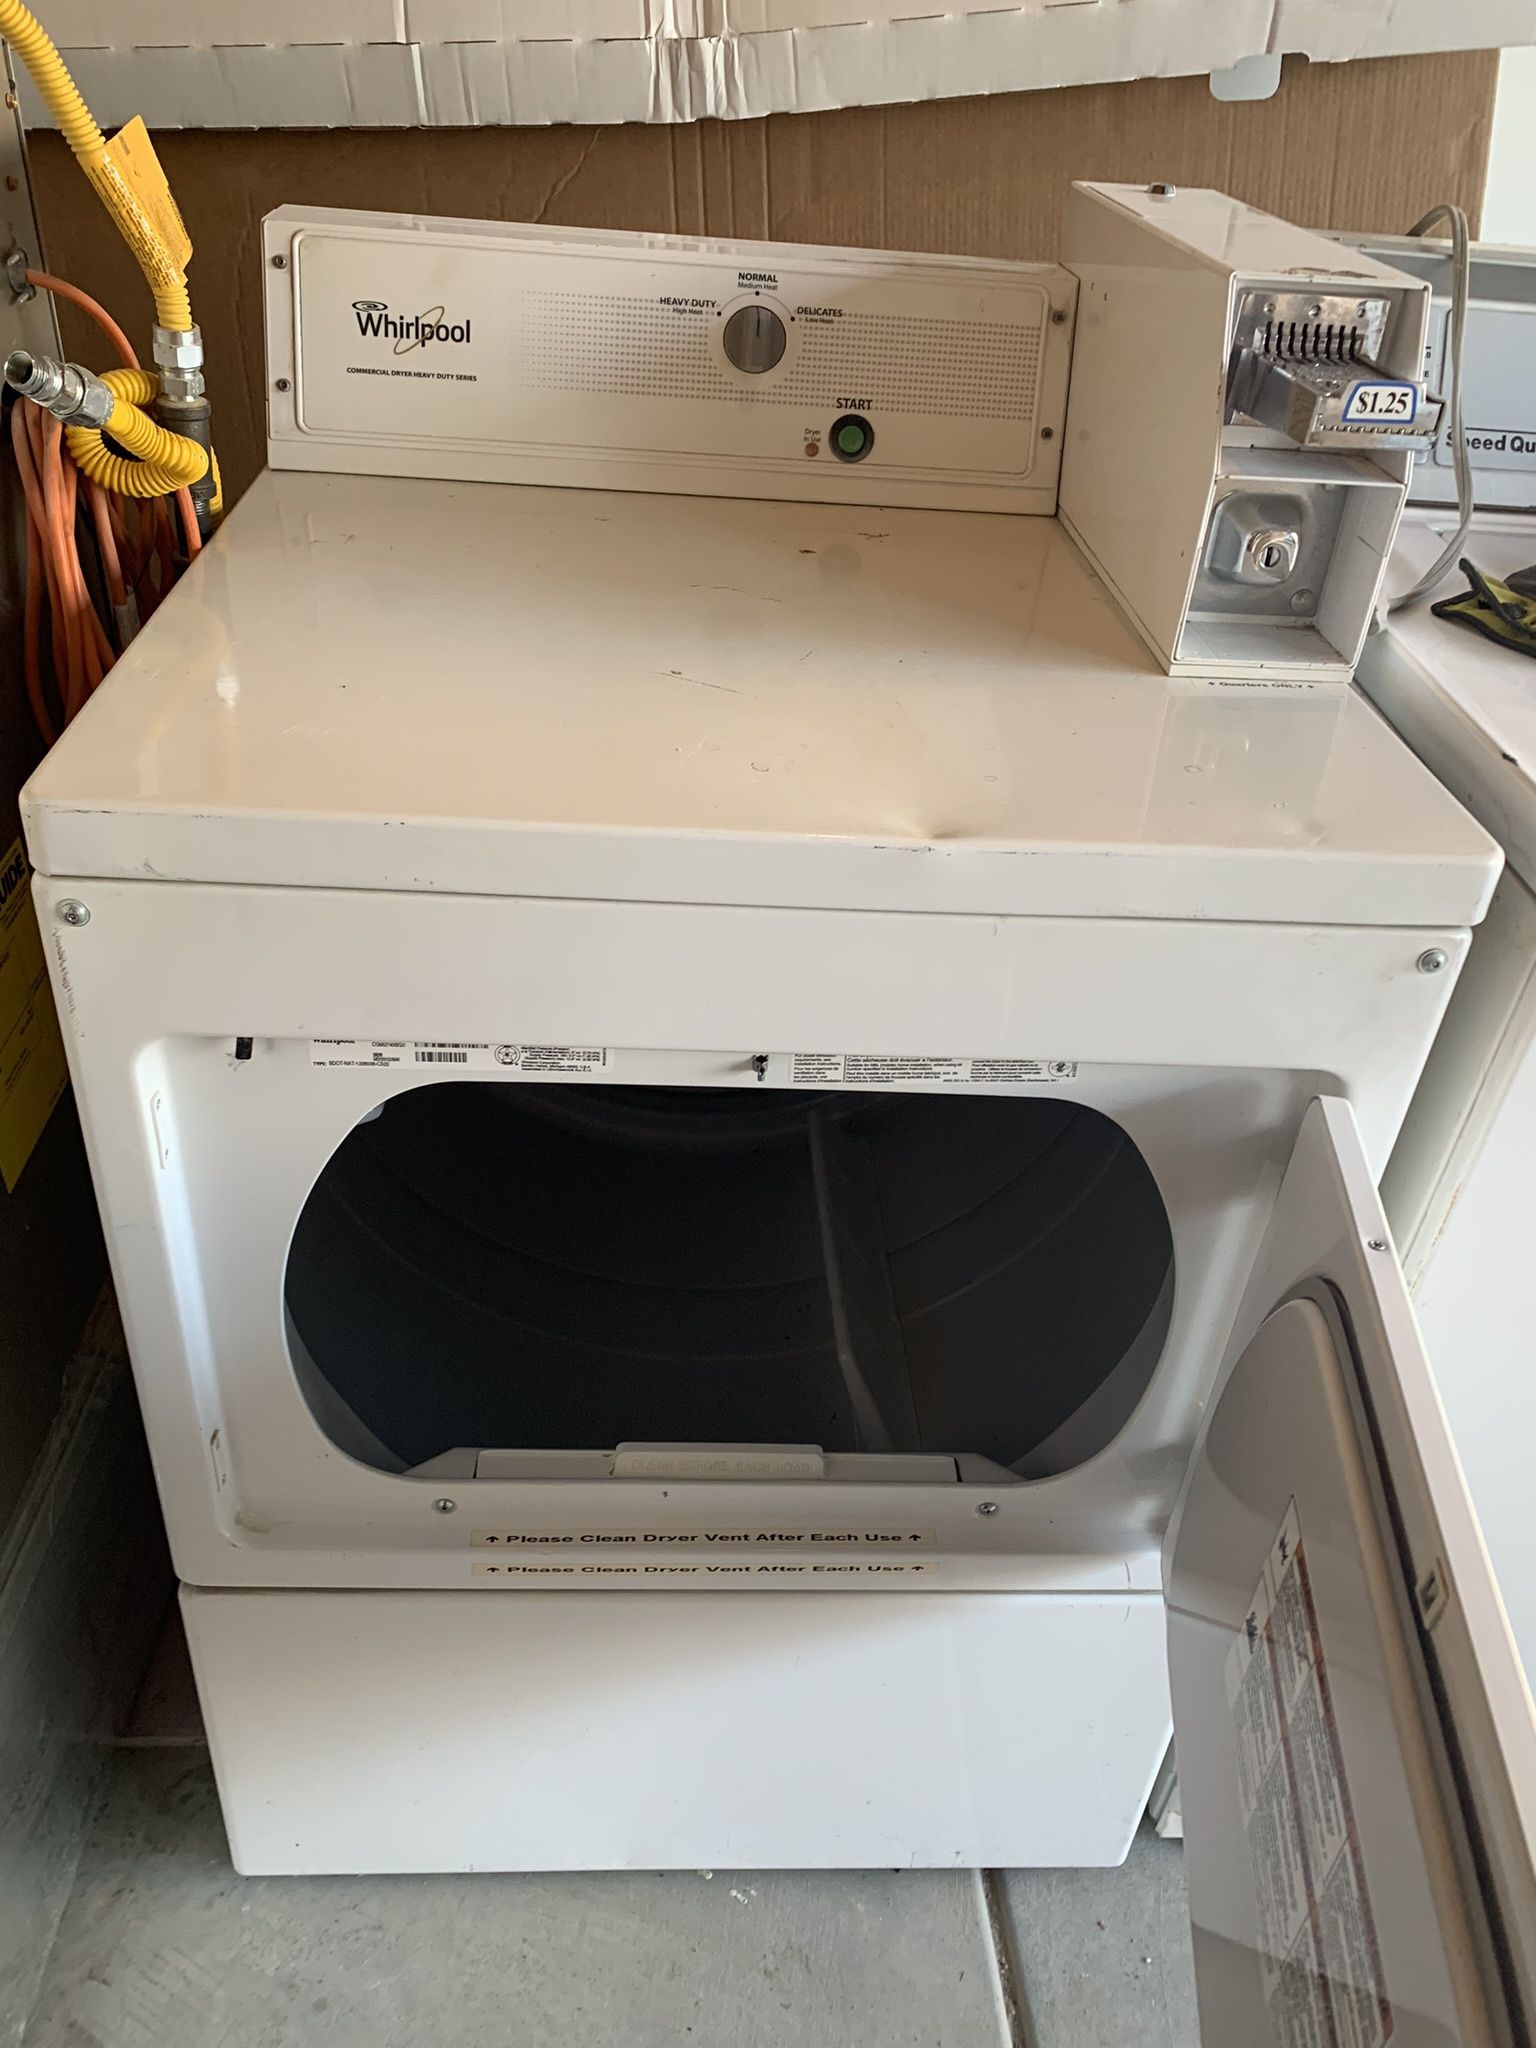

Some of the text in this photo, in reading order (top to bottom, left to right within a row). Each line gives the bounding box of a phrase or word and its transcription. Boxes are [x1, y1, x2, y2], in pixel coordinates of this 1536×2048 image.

[738, 272, 778, 283] NORMAL
[738, 282, 778, 291] Medium Heat
[660, 297, 716, 309] HEAVY DUTY
[672, 307, 703, 316] High Heat
[797, 306, 843, 317] DELICATES
[356, 311, 471, 348] Whirlpool
[346, 367, 390, 377] COMMERCIAL
[391, 370, 413, 378] DRYER
[413, 372, 435, 380] HEAVY
[836, 398, 873, 411] START
[1355, 391, 1409, 416] $1.25
[804, 428, 821, 437] Dryer
[1446, 431, 1536, 454] Seed Qu
[632, 1459, 672, 1472] CLEAN
[680, 1460, 728, 1473] BEFORE
[736, 1460, 771, 1474] EACH
[506, 1534, 902, 1543] Please Clean Dryer Vent After Each Use
